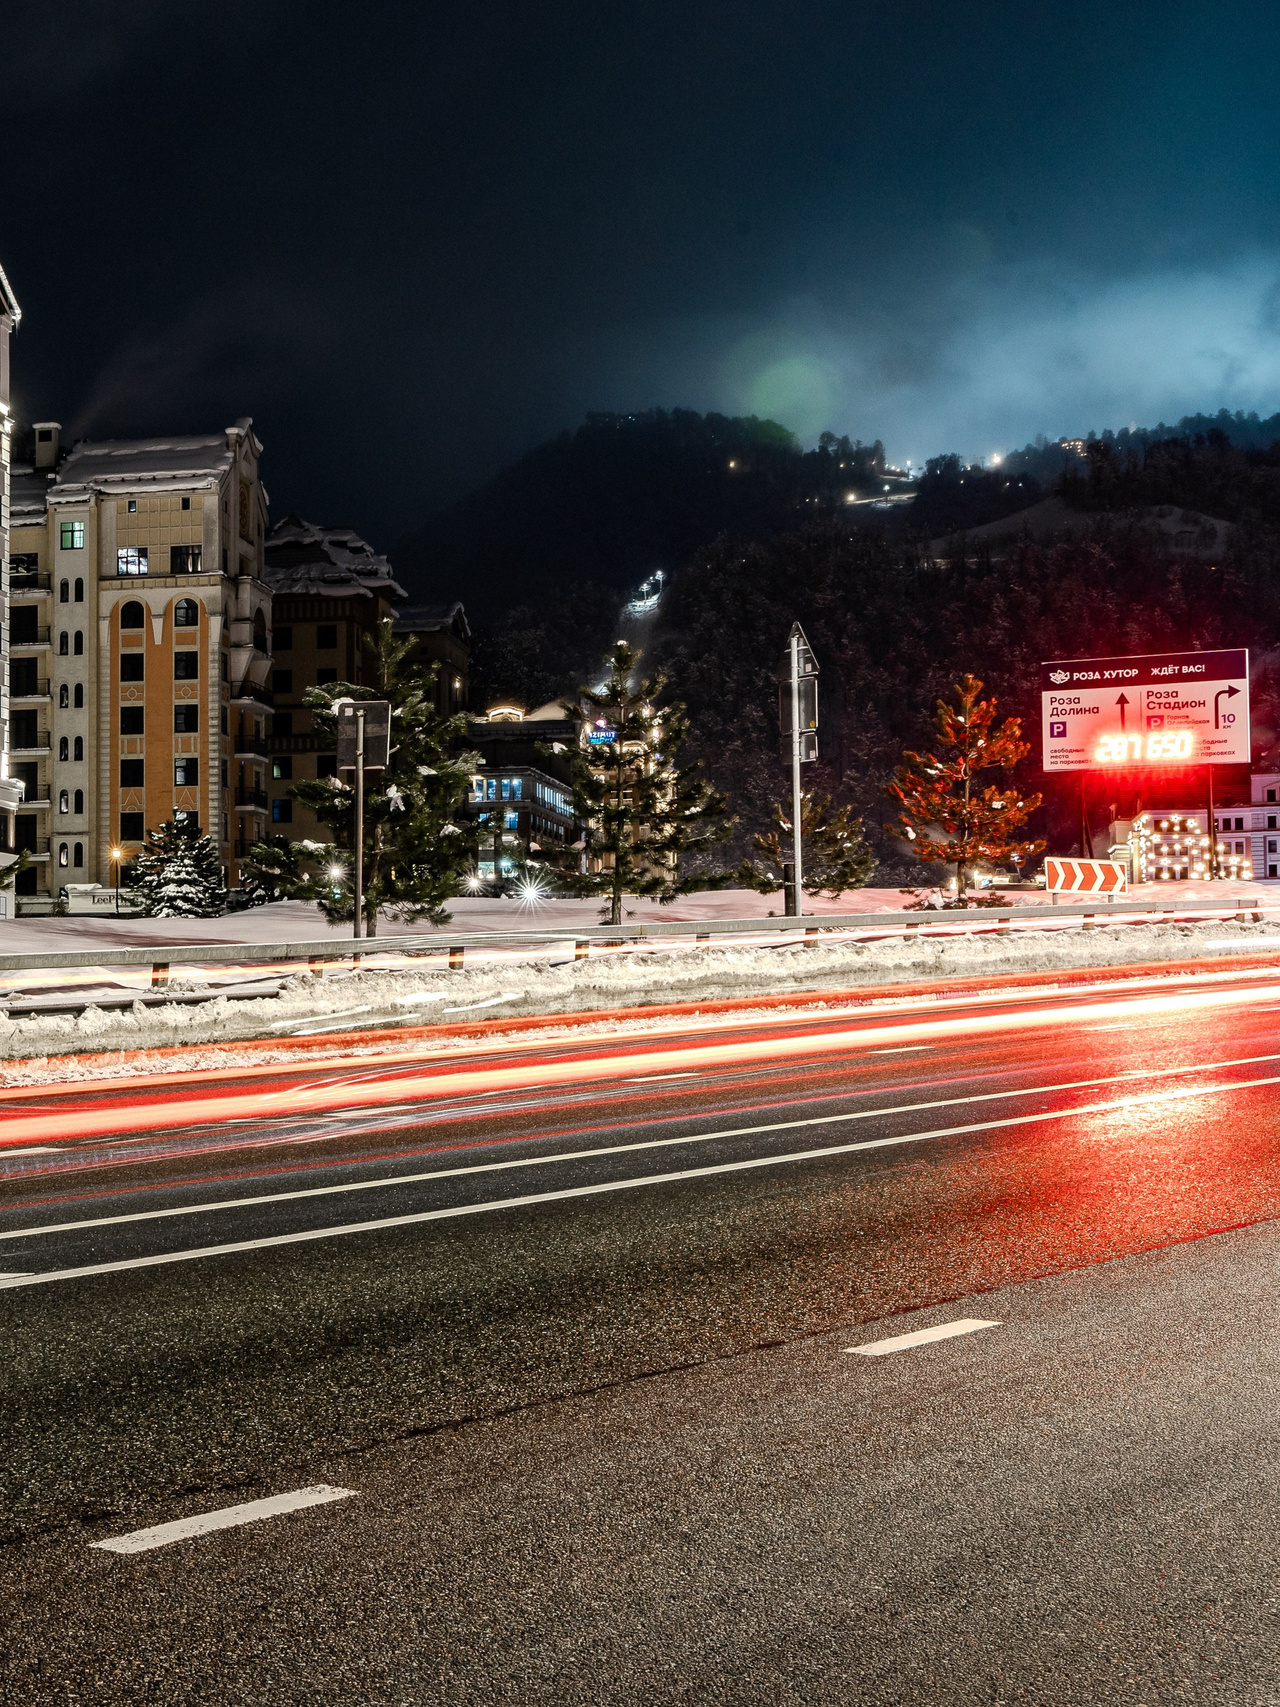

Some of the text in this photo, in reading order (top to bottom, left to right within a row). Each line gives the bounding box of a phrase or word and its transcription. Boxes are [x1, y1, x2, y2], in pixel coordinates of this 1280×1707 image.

[1073, 663, 1206, 681] РОЗА ХУТОР ЖДЁТ ВАС!
[1146, 689, 1179, 699] Роза
[1050, 696, 1081, 706] Роза
[1146, 699, 1206, 711] Стадион
[1050, 705, 1100, 718] Долина
[1221, 713, 1236, 724] 10
[1097, 736, 1141, 761] 287
[1147, 732, 1192, 758] 650
